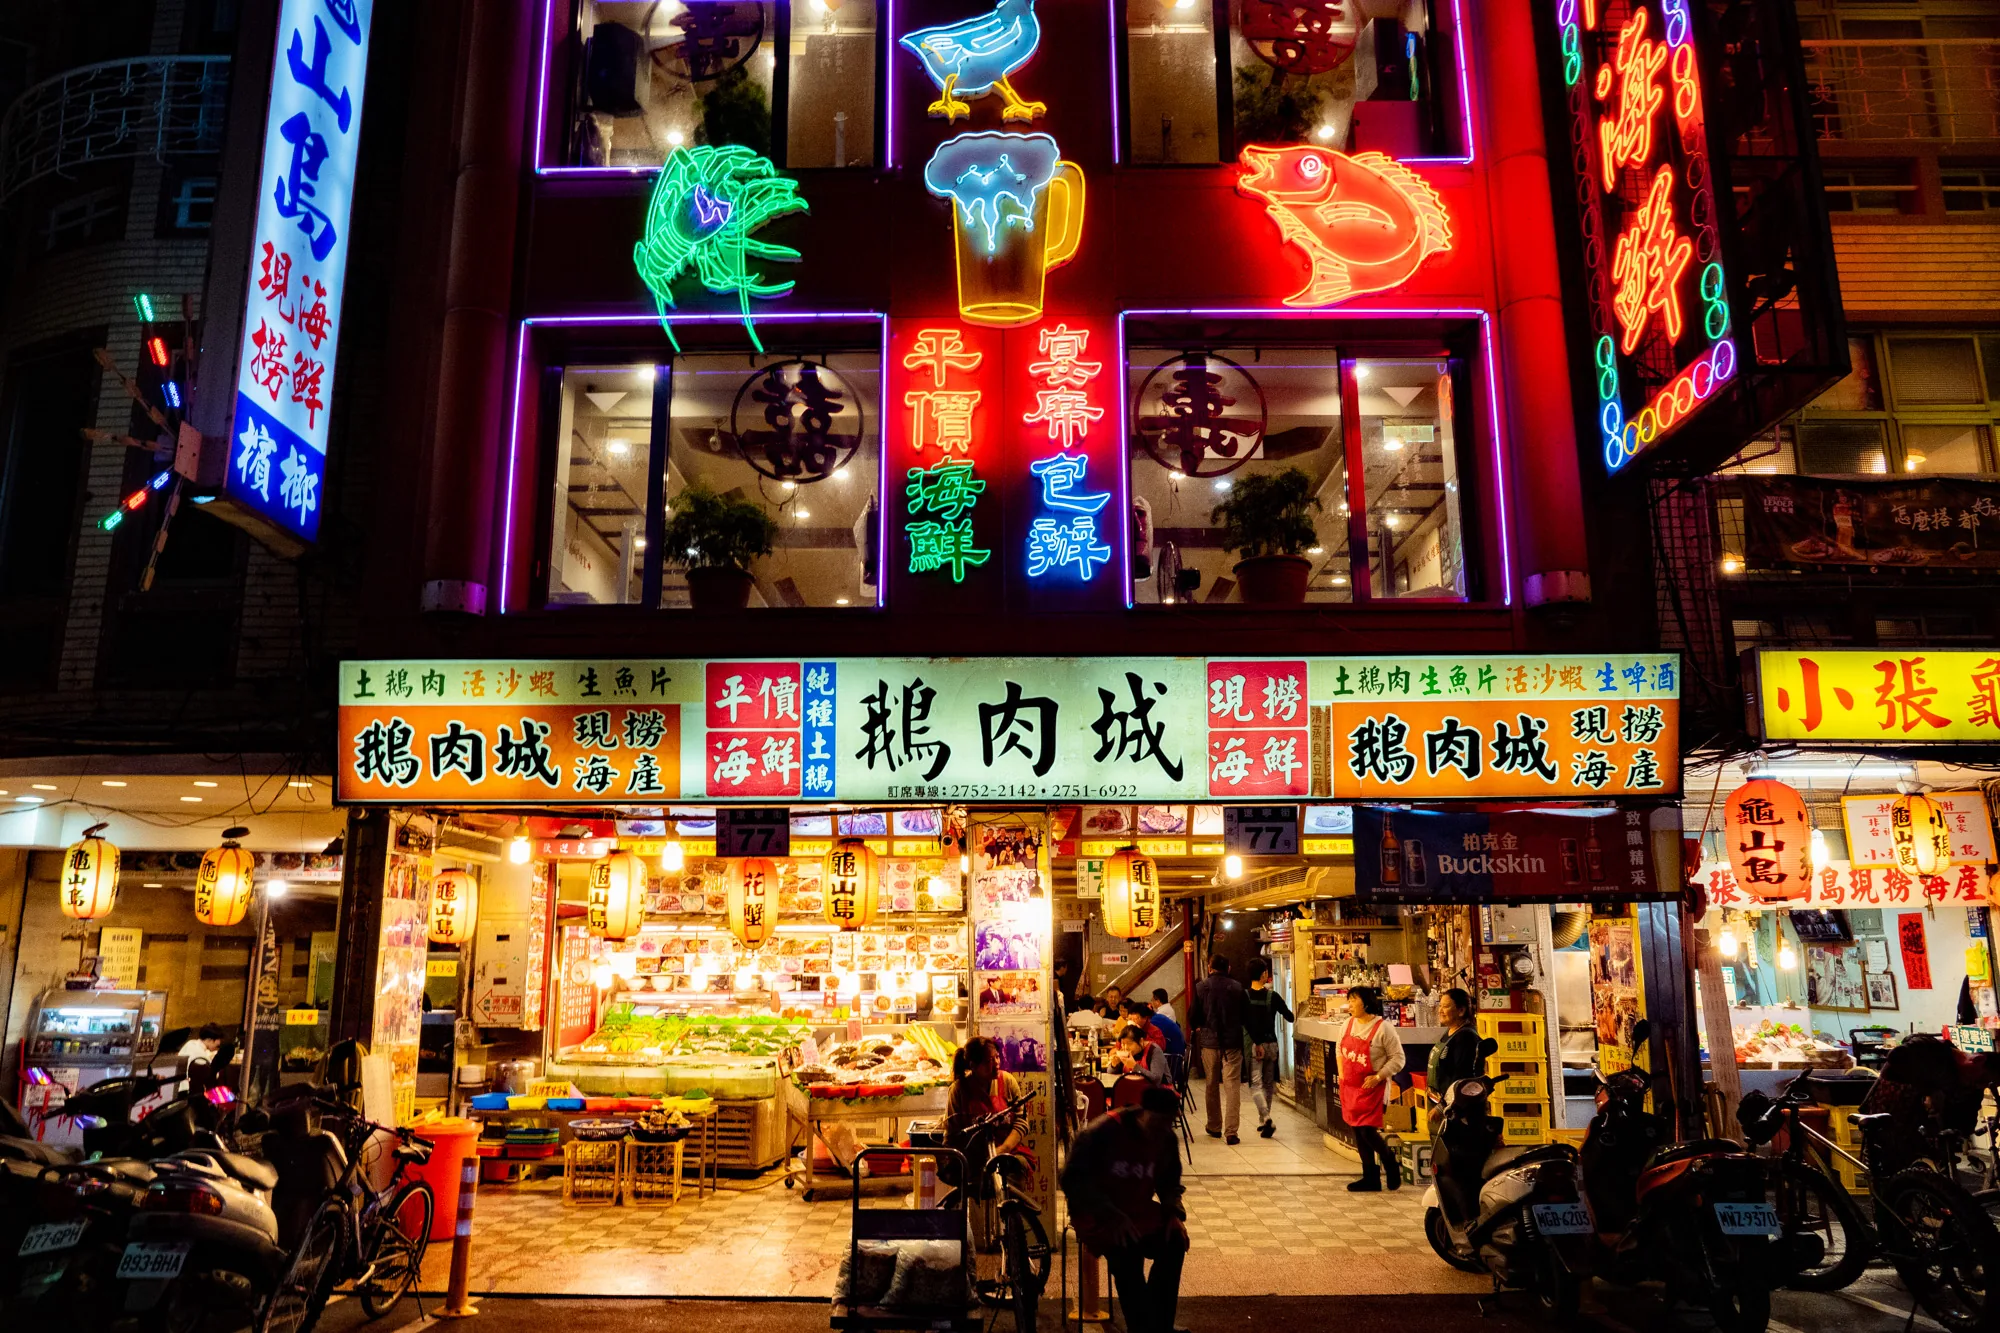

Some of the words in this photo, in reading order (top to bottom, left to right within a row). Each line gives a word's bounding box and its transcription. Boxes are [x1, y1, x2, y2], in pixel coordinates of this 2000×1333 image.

[1584, 0, 1692, 355] 海鮮
[249, 240, 295, 402] 現撈
[290, 273, 332, 430] 海鮮
[236, 415, 319, 525] 檳榔
[903, 328, 991, 583] 平價海鮮
[1023, 323, 1111, 582] 宴席包辦
[353, 667, 446, 699] 土鵝肉
[462, 667, 559, 699] 活沙蝦
[577, 667, 672, 698] 生魚片
[715, 674, 801, 724] 平價
[1208, 674, 1302, 723] 現撈
[1332, 665, 1411, 696] 土鵝肉
[1418, 664, 1498, 696] 生魚片
[1505, 664, 1587, 694] 活沙蝦
[1594, 662, 1676, 694] 生啤酒
[354, 716, 562, 788] 鵝肉城
[573, 709, 667, 750] 現撈
[803, 666, 836, 794] 純種土鵝
[855, 671, 1184, 783] 鵝肉城
[1348, 714, 1559, 783] 鵝肉城
[1570, 704, 1665, 745] 現撈
[572, 754, 666, 794] 海產
[712, 734, 802, 786] 海鮮
[1208, 736, 1303, 786] 海鮮
[1569, 748, 1664, 790] 海產
[736, 828, 776, 852] 77
[1245, 826, 1284, 850] 77
[1436, 853, 1547, 875] Buckskin
[1462, 832, 1519, 851] 柏克金
[1626, 810, 1647, 886] 致釀精采
[1737, 797, 1789, 885] 龜山島
[1892, 806, 1918, 867] 龜山島
[68, 849, 91, 908] 龜山島
[197, 858, 218, 918] 龜山島
[743, 871, 766, 928] 花蟹
[831, 851, 858, 920] 龜山島
[1131, 859, 1155, 928] 龜山島
[435, 881, 458, 937] 龜山島
[1491, 997, 1503, 1008] 75
[120, 1253, 180, 1273] 893-BHA
